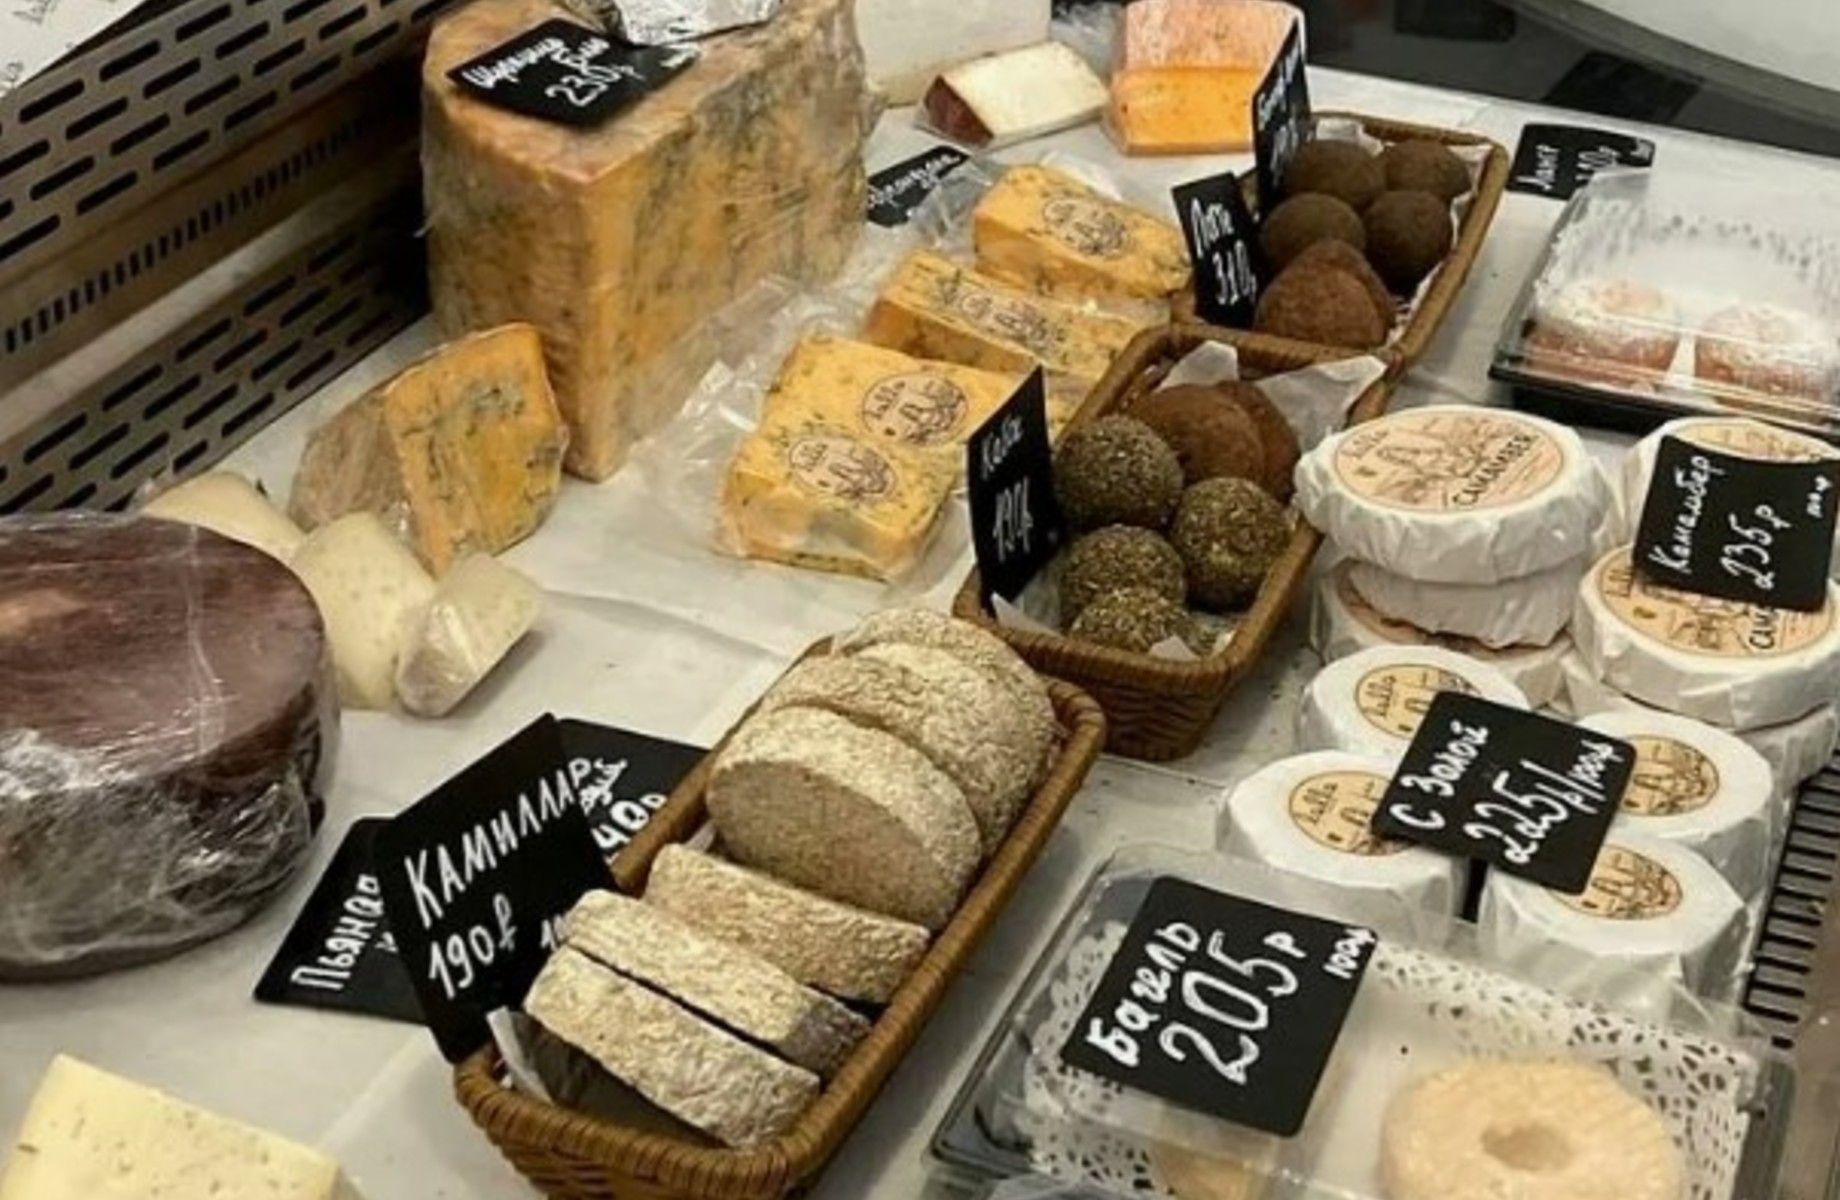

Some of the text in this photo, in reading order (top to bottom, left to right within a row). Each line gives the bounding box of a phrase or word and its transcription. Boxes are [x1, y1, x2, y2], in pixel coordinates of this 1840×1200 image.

[1648, 455, 1726, 575] Камамбер
[1719, 511, 1792, 591] 235р
[1389, 802, 1446, 831] С
